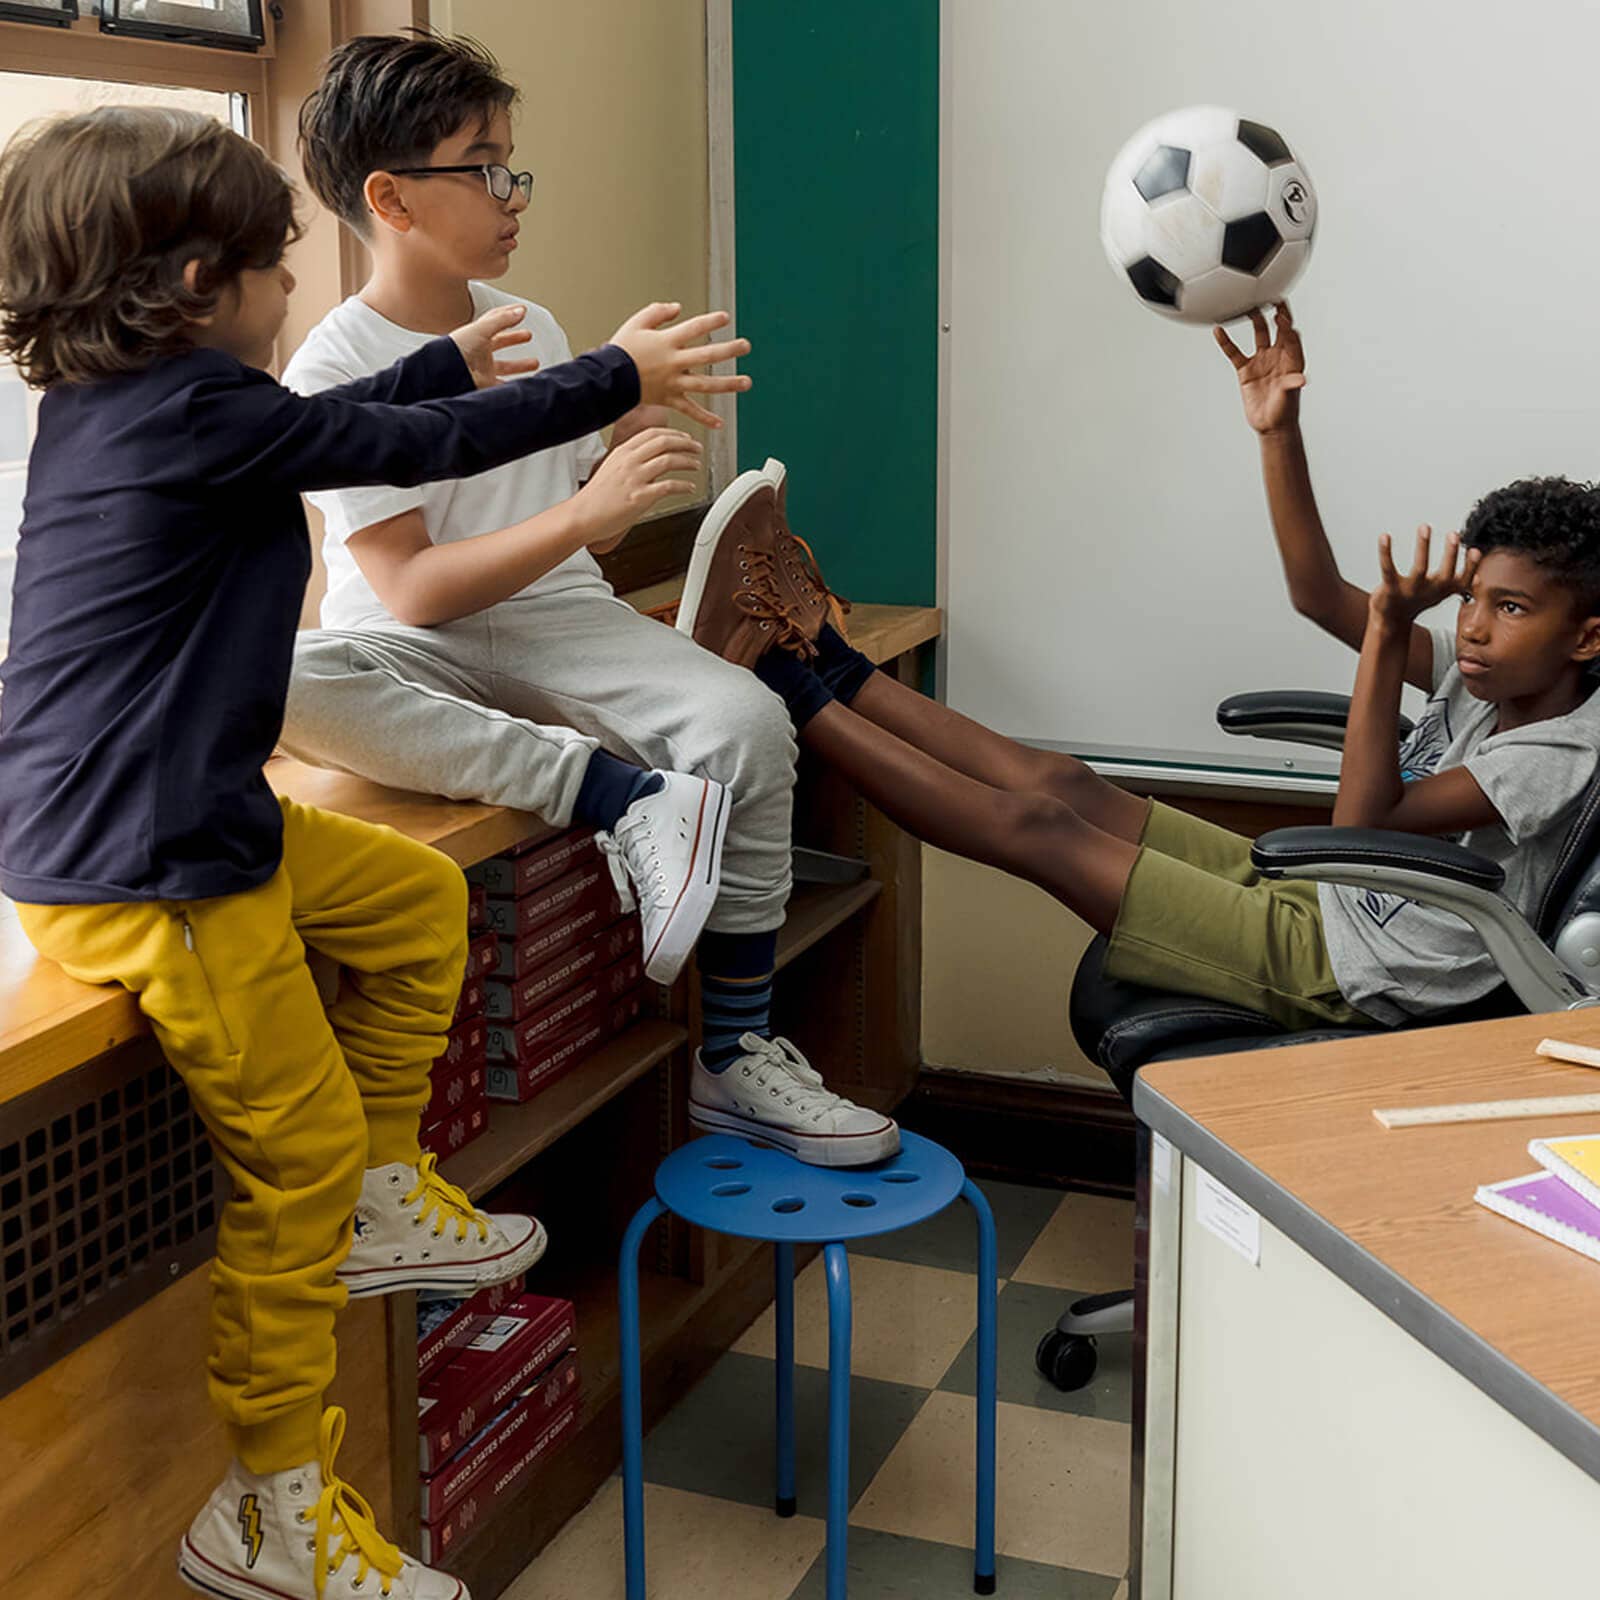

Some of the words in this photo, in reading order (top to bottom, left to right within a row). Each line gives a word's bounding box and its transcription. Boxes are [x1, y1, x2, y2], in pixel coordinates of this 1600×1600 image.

[527, 898, 551, 918] UNITED
[551, 886, 573, 904] STATES
[525, 937, 548, 957] UNITED
[548, 925, 570, 943] STATES
[523, 979, 547, 1000] UNITED
[547, 965, 570, 986] STATES
[524, 1018, 549, 1040] UNITED
[548, 1005, 572, 1025] STATES
[527, 1058, 552, 1081] UNITED
[552, 1043, 575, 1065] STATES
[418, 1339, 445, 1368] STATES
[444, 1312, 475, 1344] HISTORY
[546, 1325, 572, 1353] UNITED
[521, 1348, 547, 1376] STATES
[549, 1410, 574, 1439] UNITED
[443, 1465, 471, 1497] UNITED
[471, 1438, 498, 1470] STATES
[498, 1408, 528, 1444] HISTORY
[524, 1434, 549, 1464] STATES
